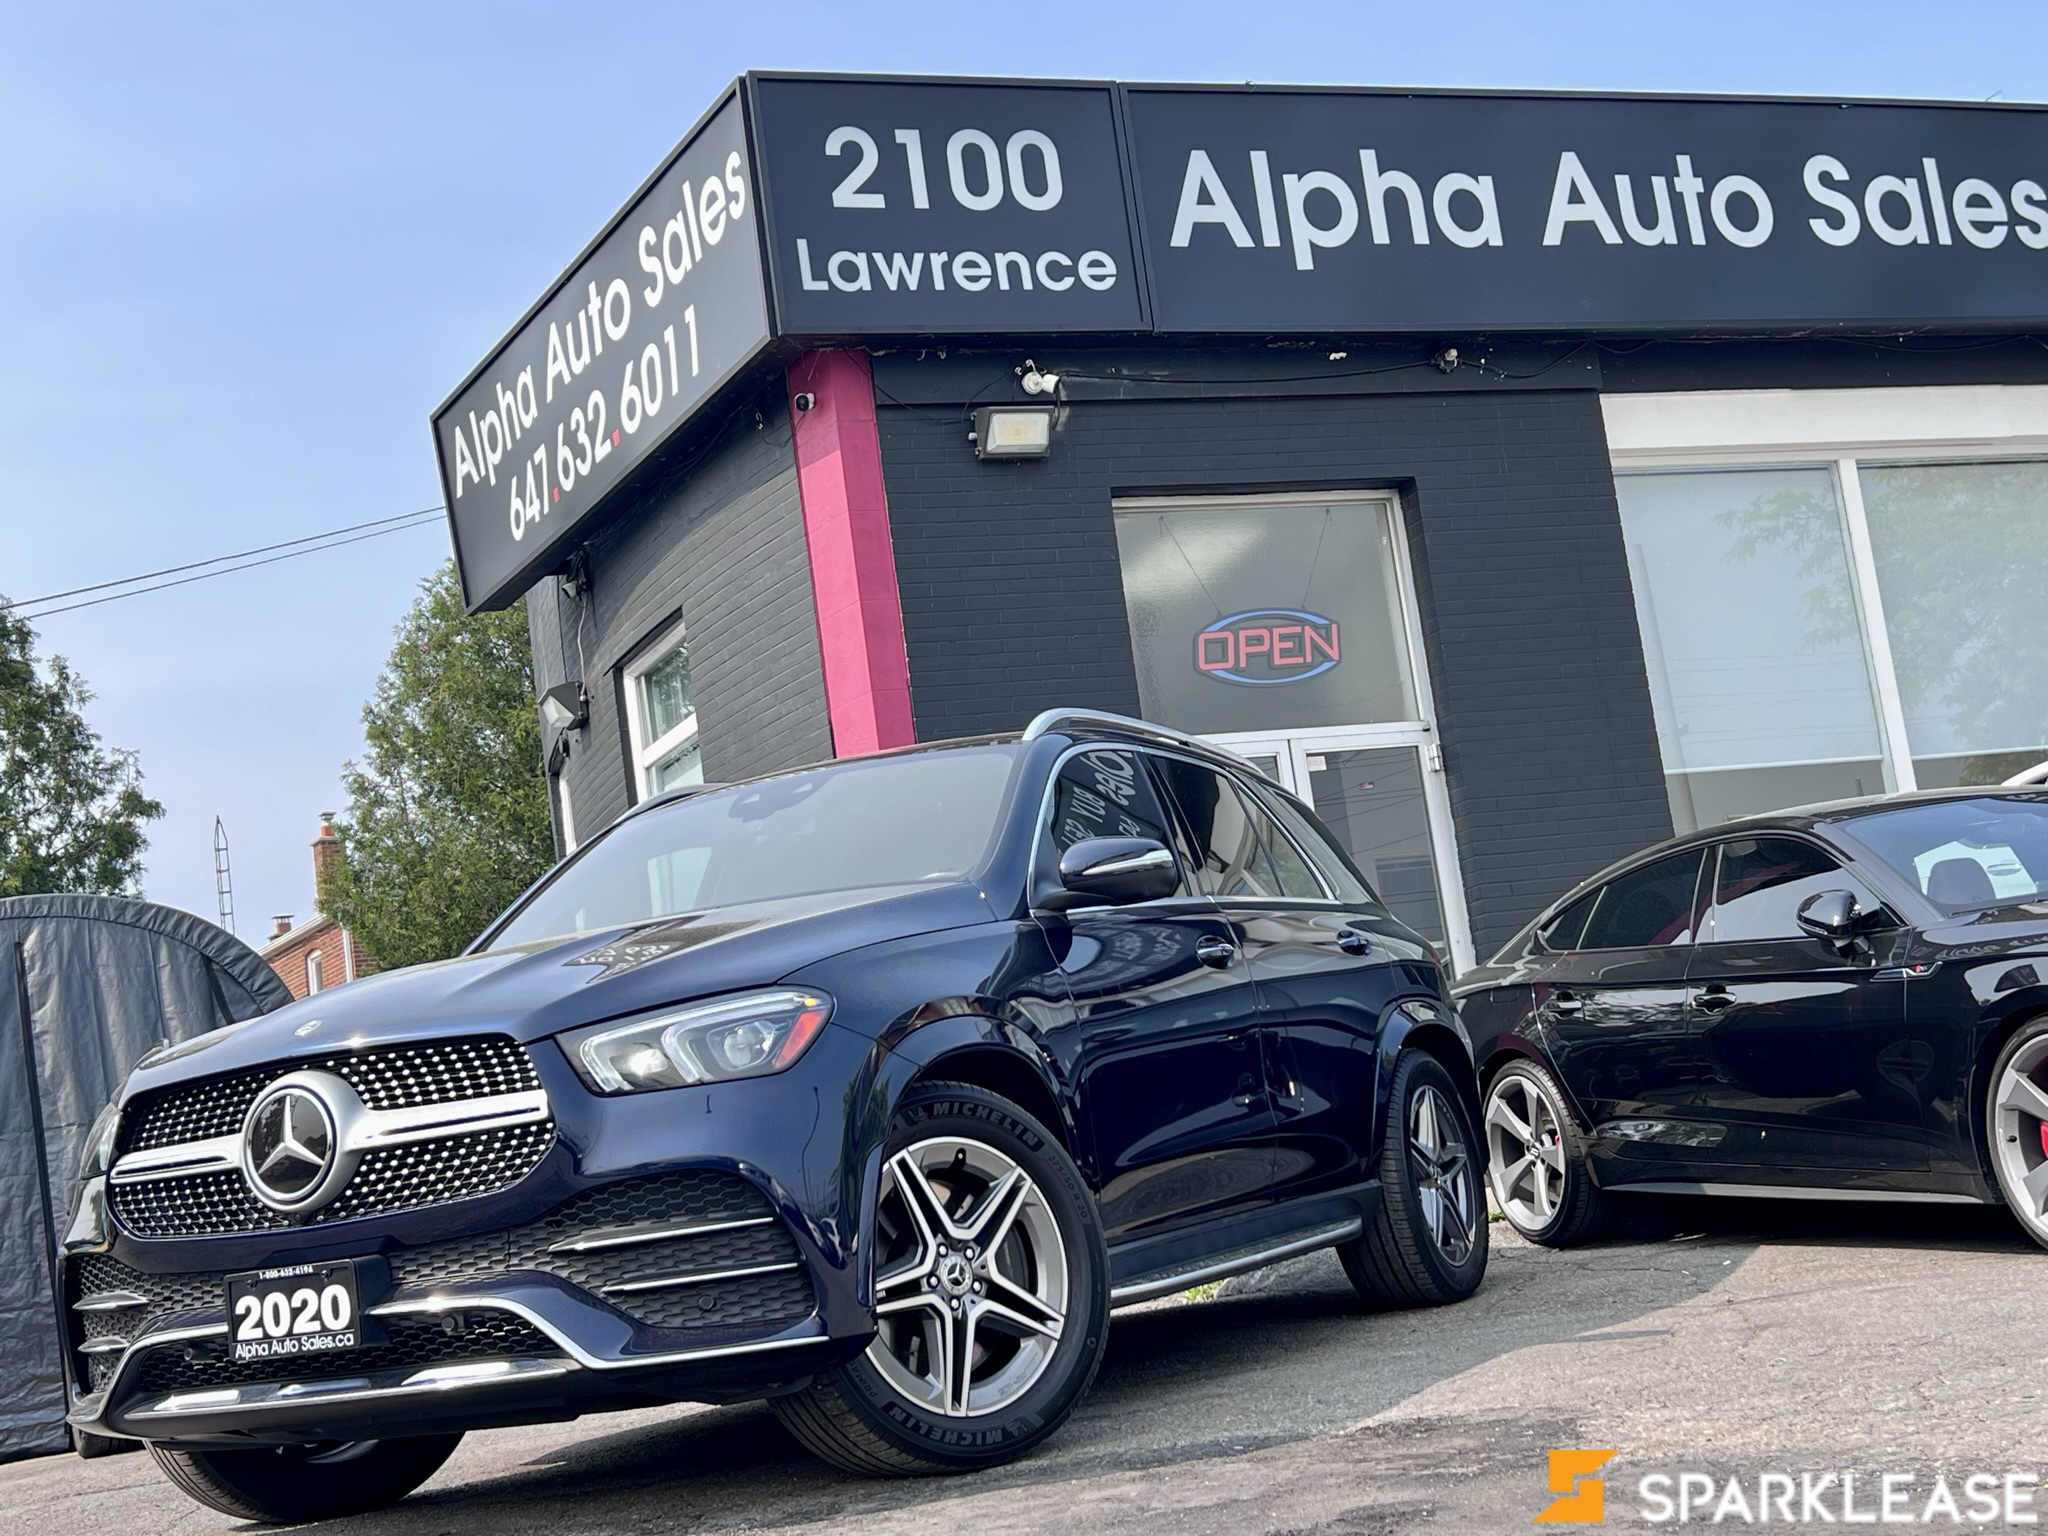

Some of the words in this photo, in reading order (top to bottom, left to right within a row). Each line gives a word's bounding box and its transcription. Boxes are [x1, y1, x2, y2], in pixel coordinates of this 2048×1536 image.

[824, 126, 1063, 211] 2100
[1170, 149, 1504, 271] Alpha
[1542, 151, 1774, 248] Auto
[1803, 154, 2048, 250] Sales
[796, 238, 1117, 292] Lawrence
[454, 366, 538, 498] Alpha
[546, 279, 631, 404] Auto
[638, 151, 746, 308] Sales
[510, 304, 699, 541] 647.632.6011
[1198, 623, 1340, 671] OPEN
[932, 1102, 1042, 1149] MICHELIN
[234, 1284, 351, 1341] 2020
[235, 1342, 269, 1360] Alpha
[271, 1339, 299, 1354] Auto
[301, 1333, 355, 1351] Sales.ca
[888, 1403, 1003, 1446] MICHELIN
